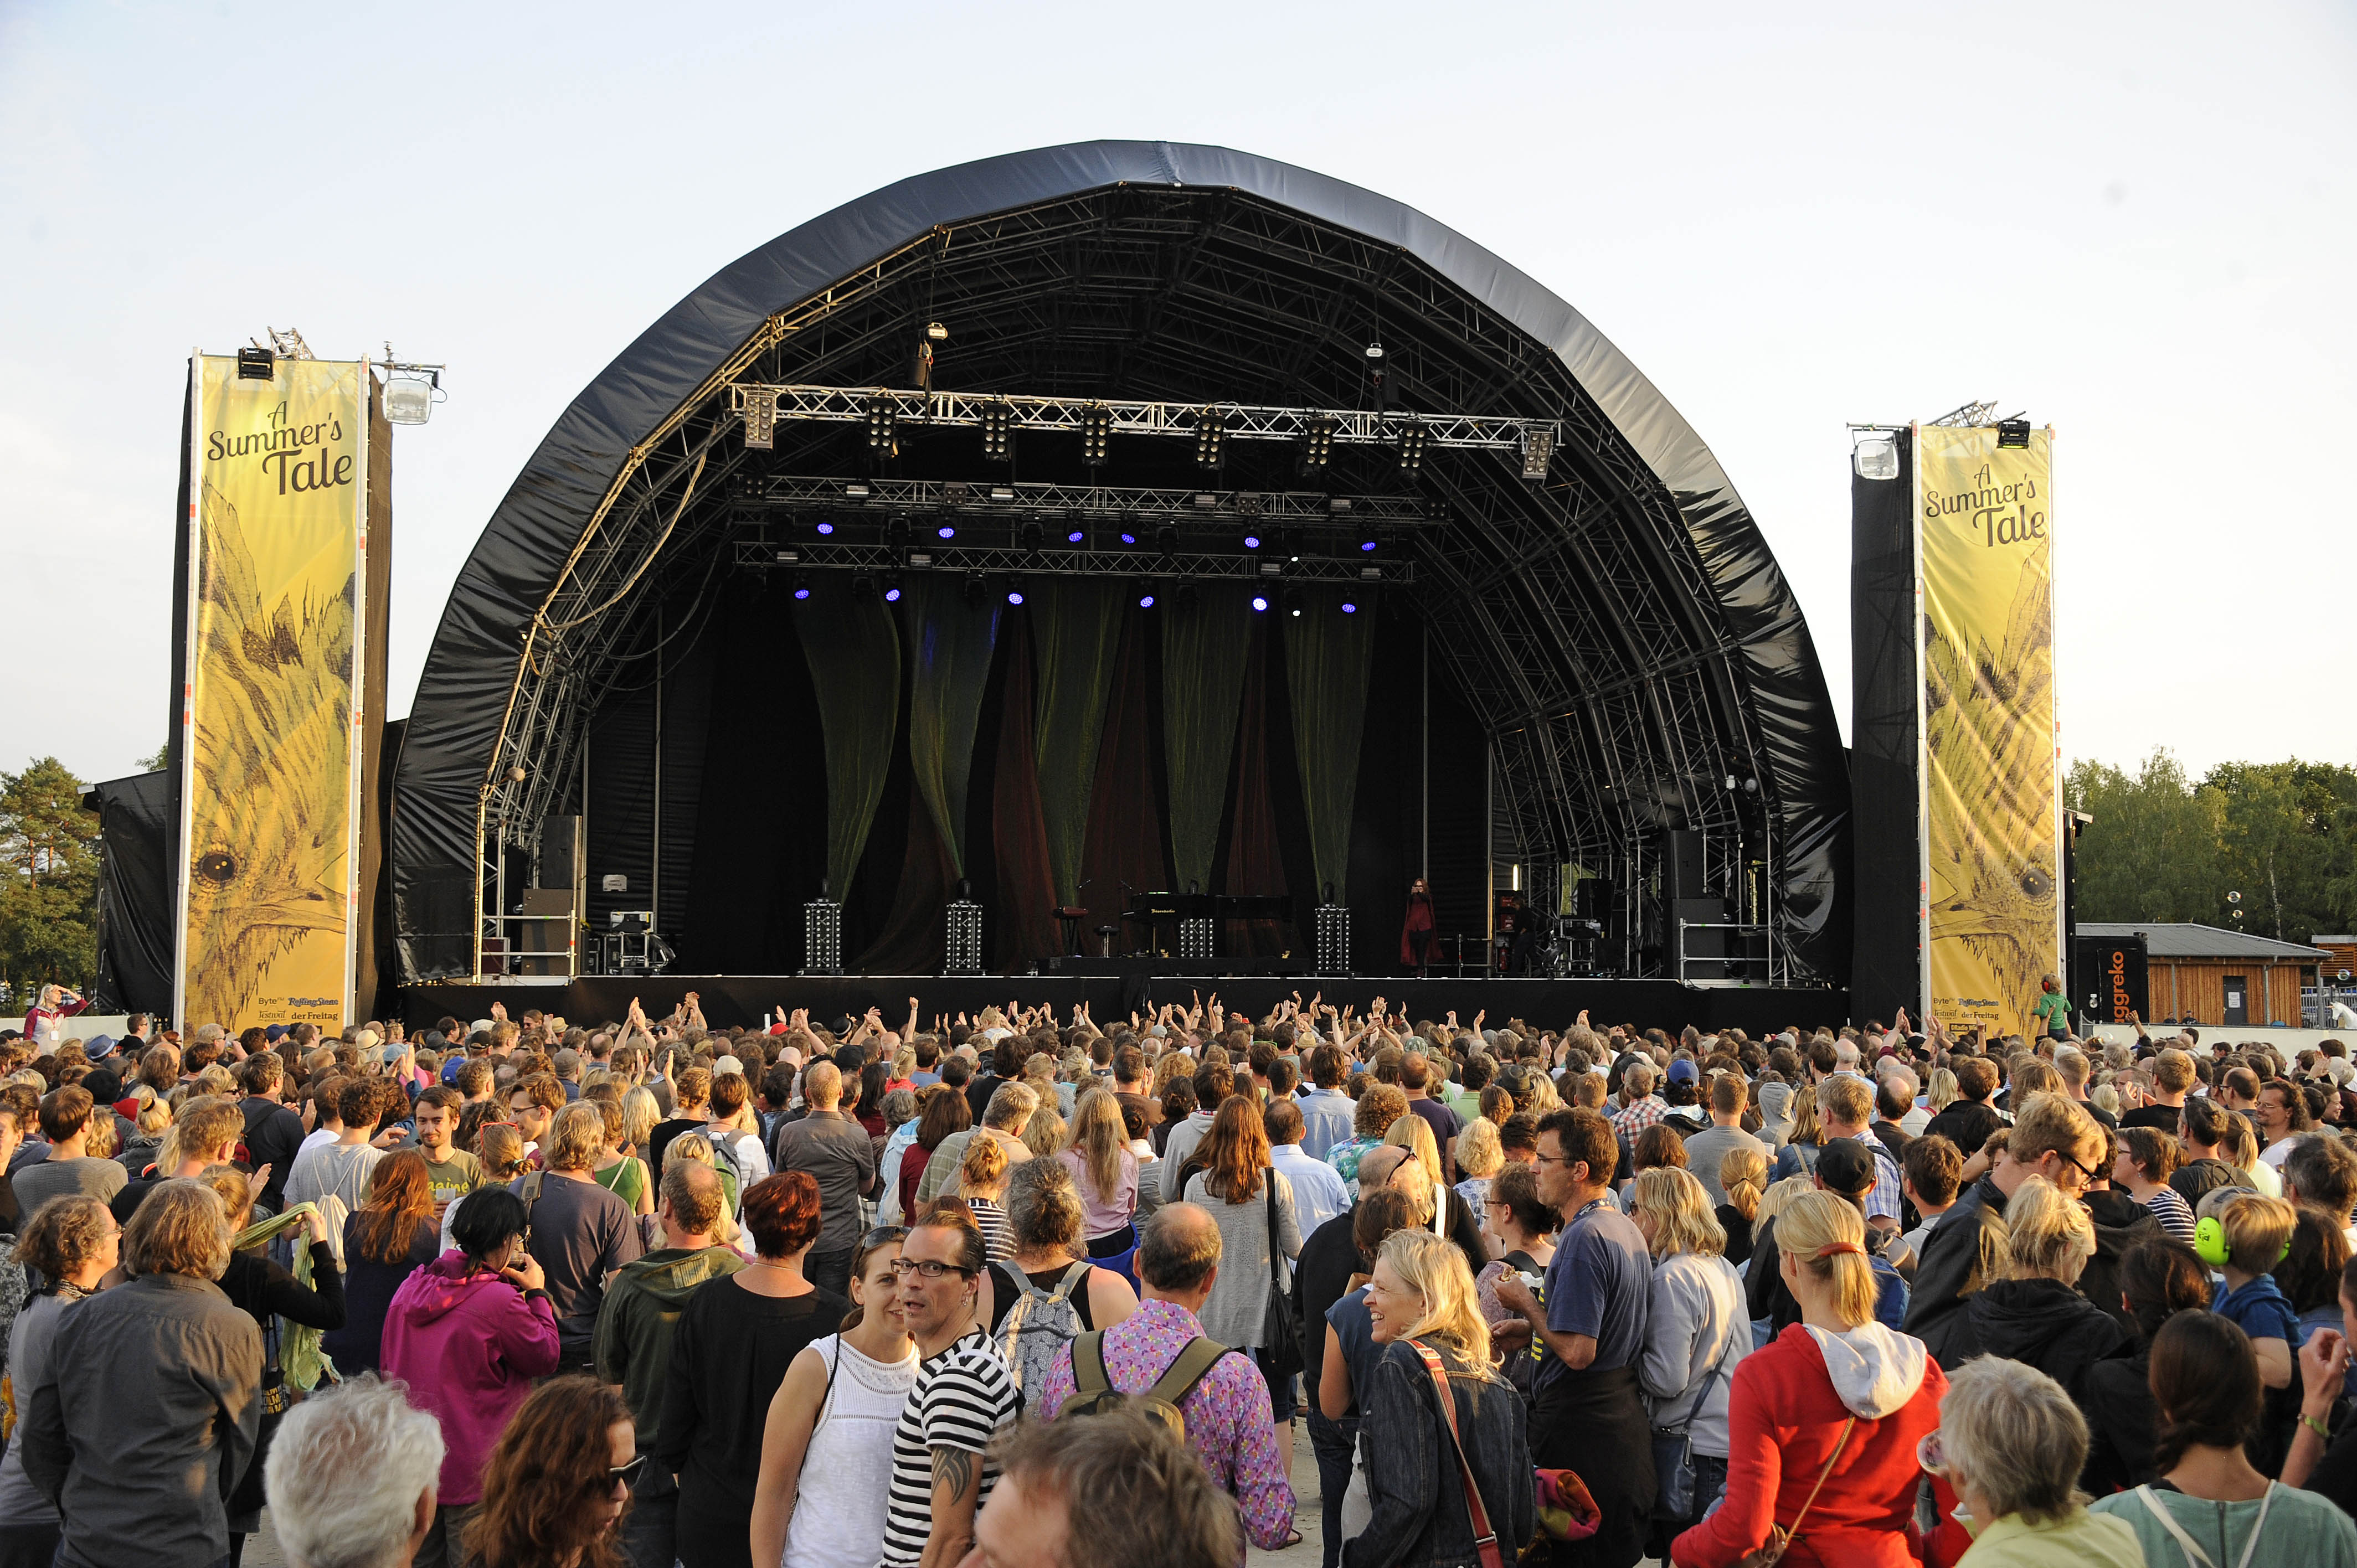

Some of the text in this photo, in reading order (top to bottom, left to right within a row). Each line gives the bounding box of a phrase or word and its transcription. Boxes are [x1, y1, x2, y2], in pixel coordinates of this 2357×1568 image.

[267, 400, 287, 429] A
[207, 412, 343, 461] Summer's
[262, 447, 353, 496] Tale
[1974, 463, 1990, 489] A
[1926, 473, 2036, 518] Summer's
[1972, 504, 2046, 548] Tale
[307, 1012, 339, 1020] Freitag
[1974, 1012, 1999, 1020] Freitag
